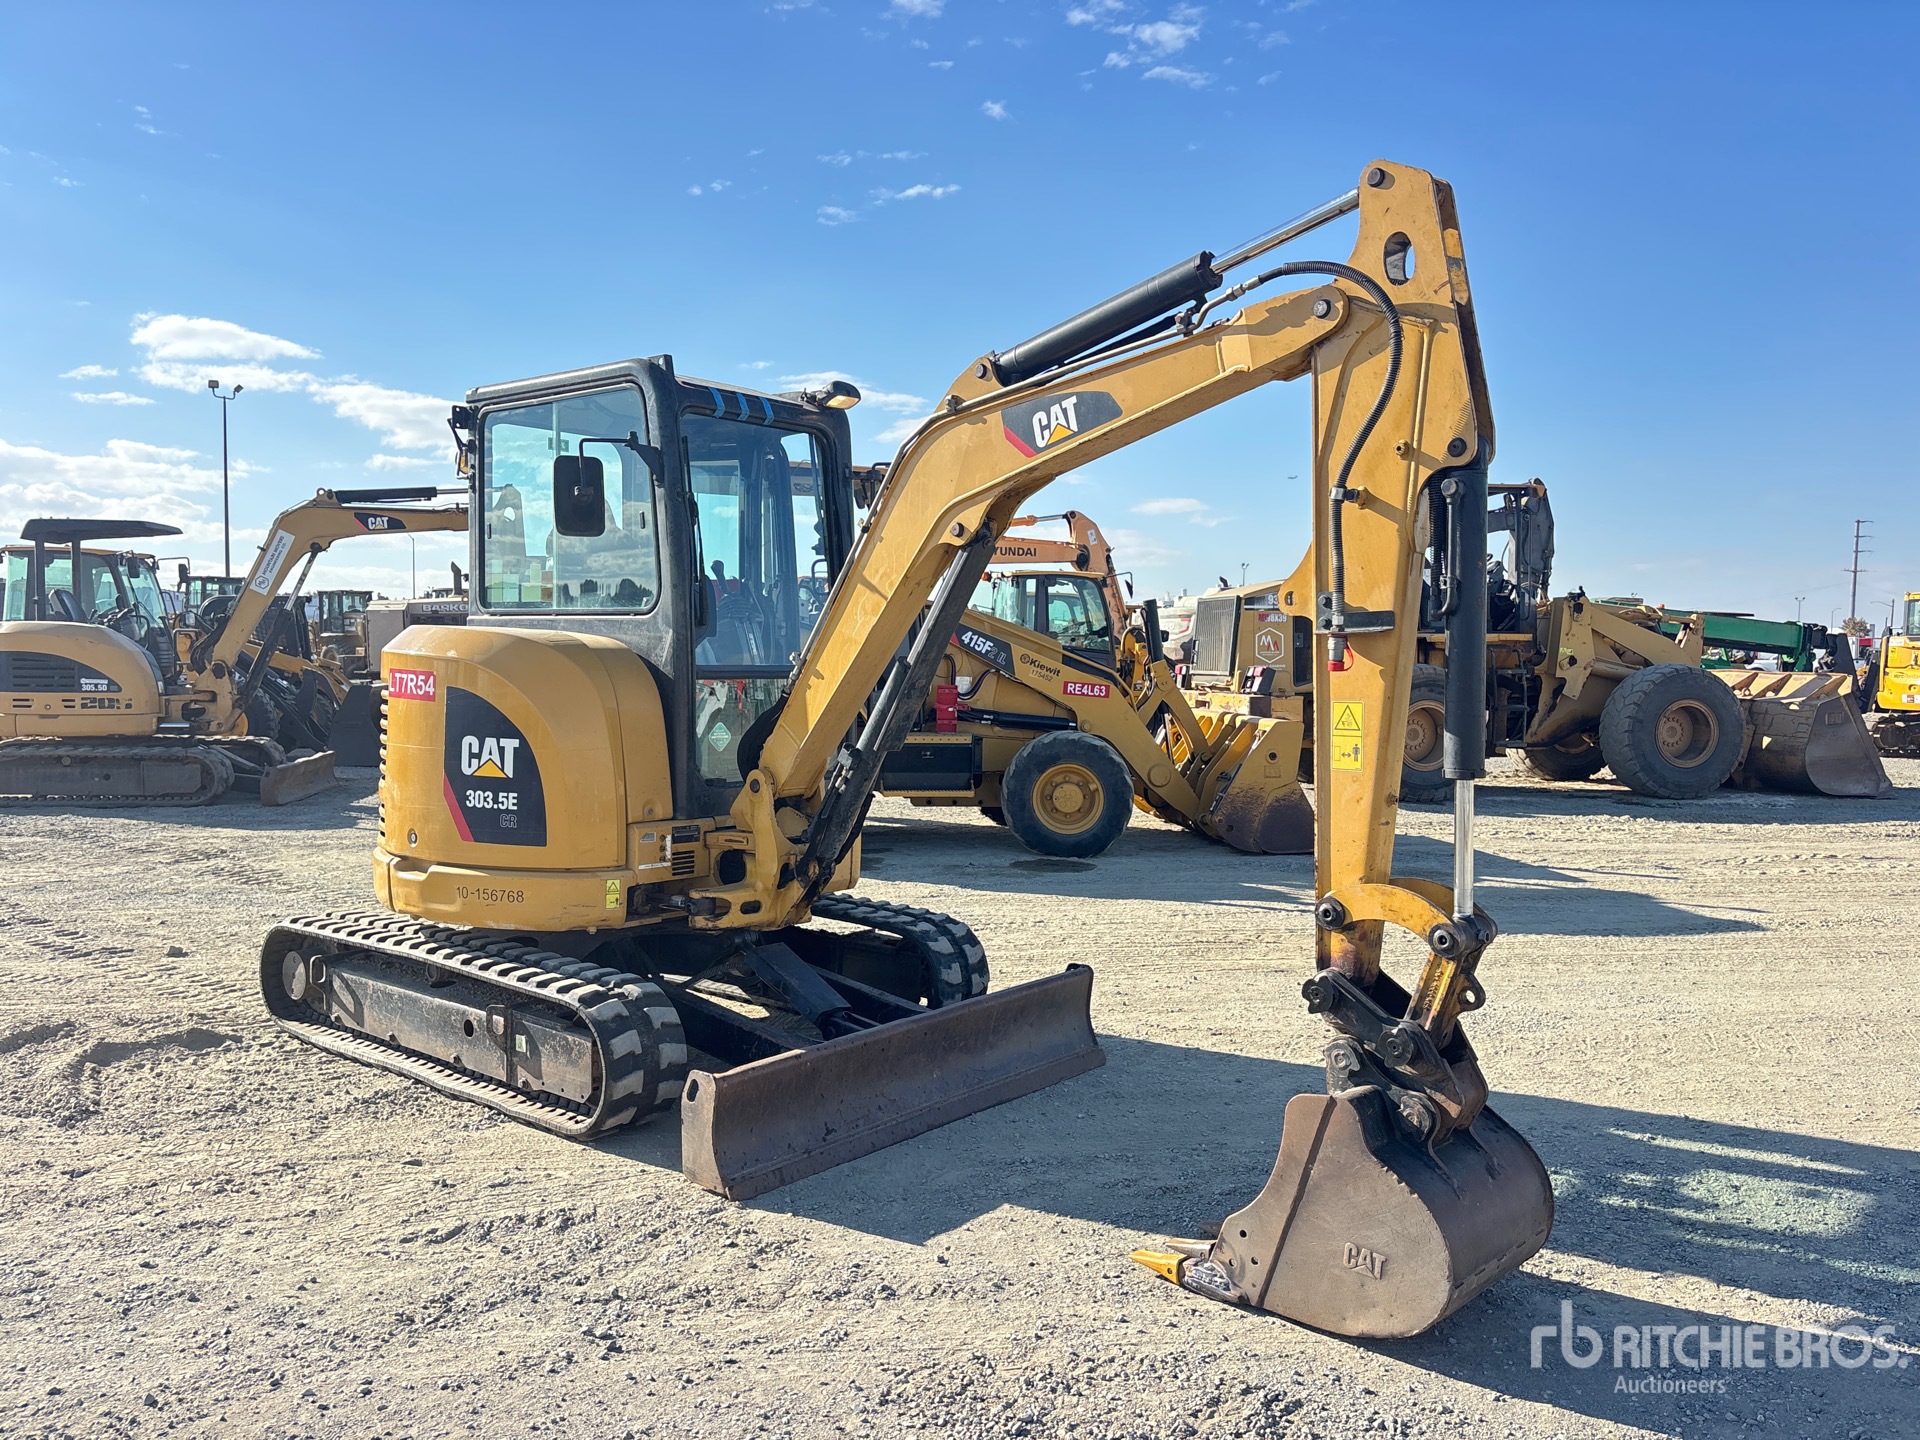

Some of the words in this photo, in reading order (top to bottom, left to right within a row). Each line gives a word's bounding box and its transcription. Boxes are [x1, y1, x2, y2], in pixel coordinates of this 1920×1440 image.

[1032, 395, 1078, 448] CAT
[368, 517, 389, 530] CAT
[993, 547, 1037, 557] YUNDAI
[422, 603, 469, 612] BARKO
[1267, 594, 1279, 605] 93
[1029, 658, 1061, 677] Kiewit
[1030, 669, 1054, 682] 175452
[389, 672, 435, 696] LT7R54
[1067, 683, 1106, 696] RE4L63
[461, 735, 520, 778] CAT
[465, 789, 518, 810] 303.5E
[500, 814, 518, 829] CR
[456, 886, 525, 903] 10-156768
[1343, 1242, 1387, 1280] CAT
